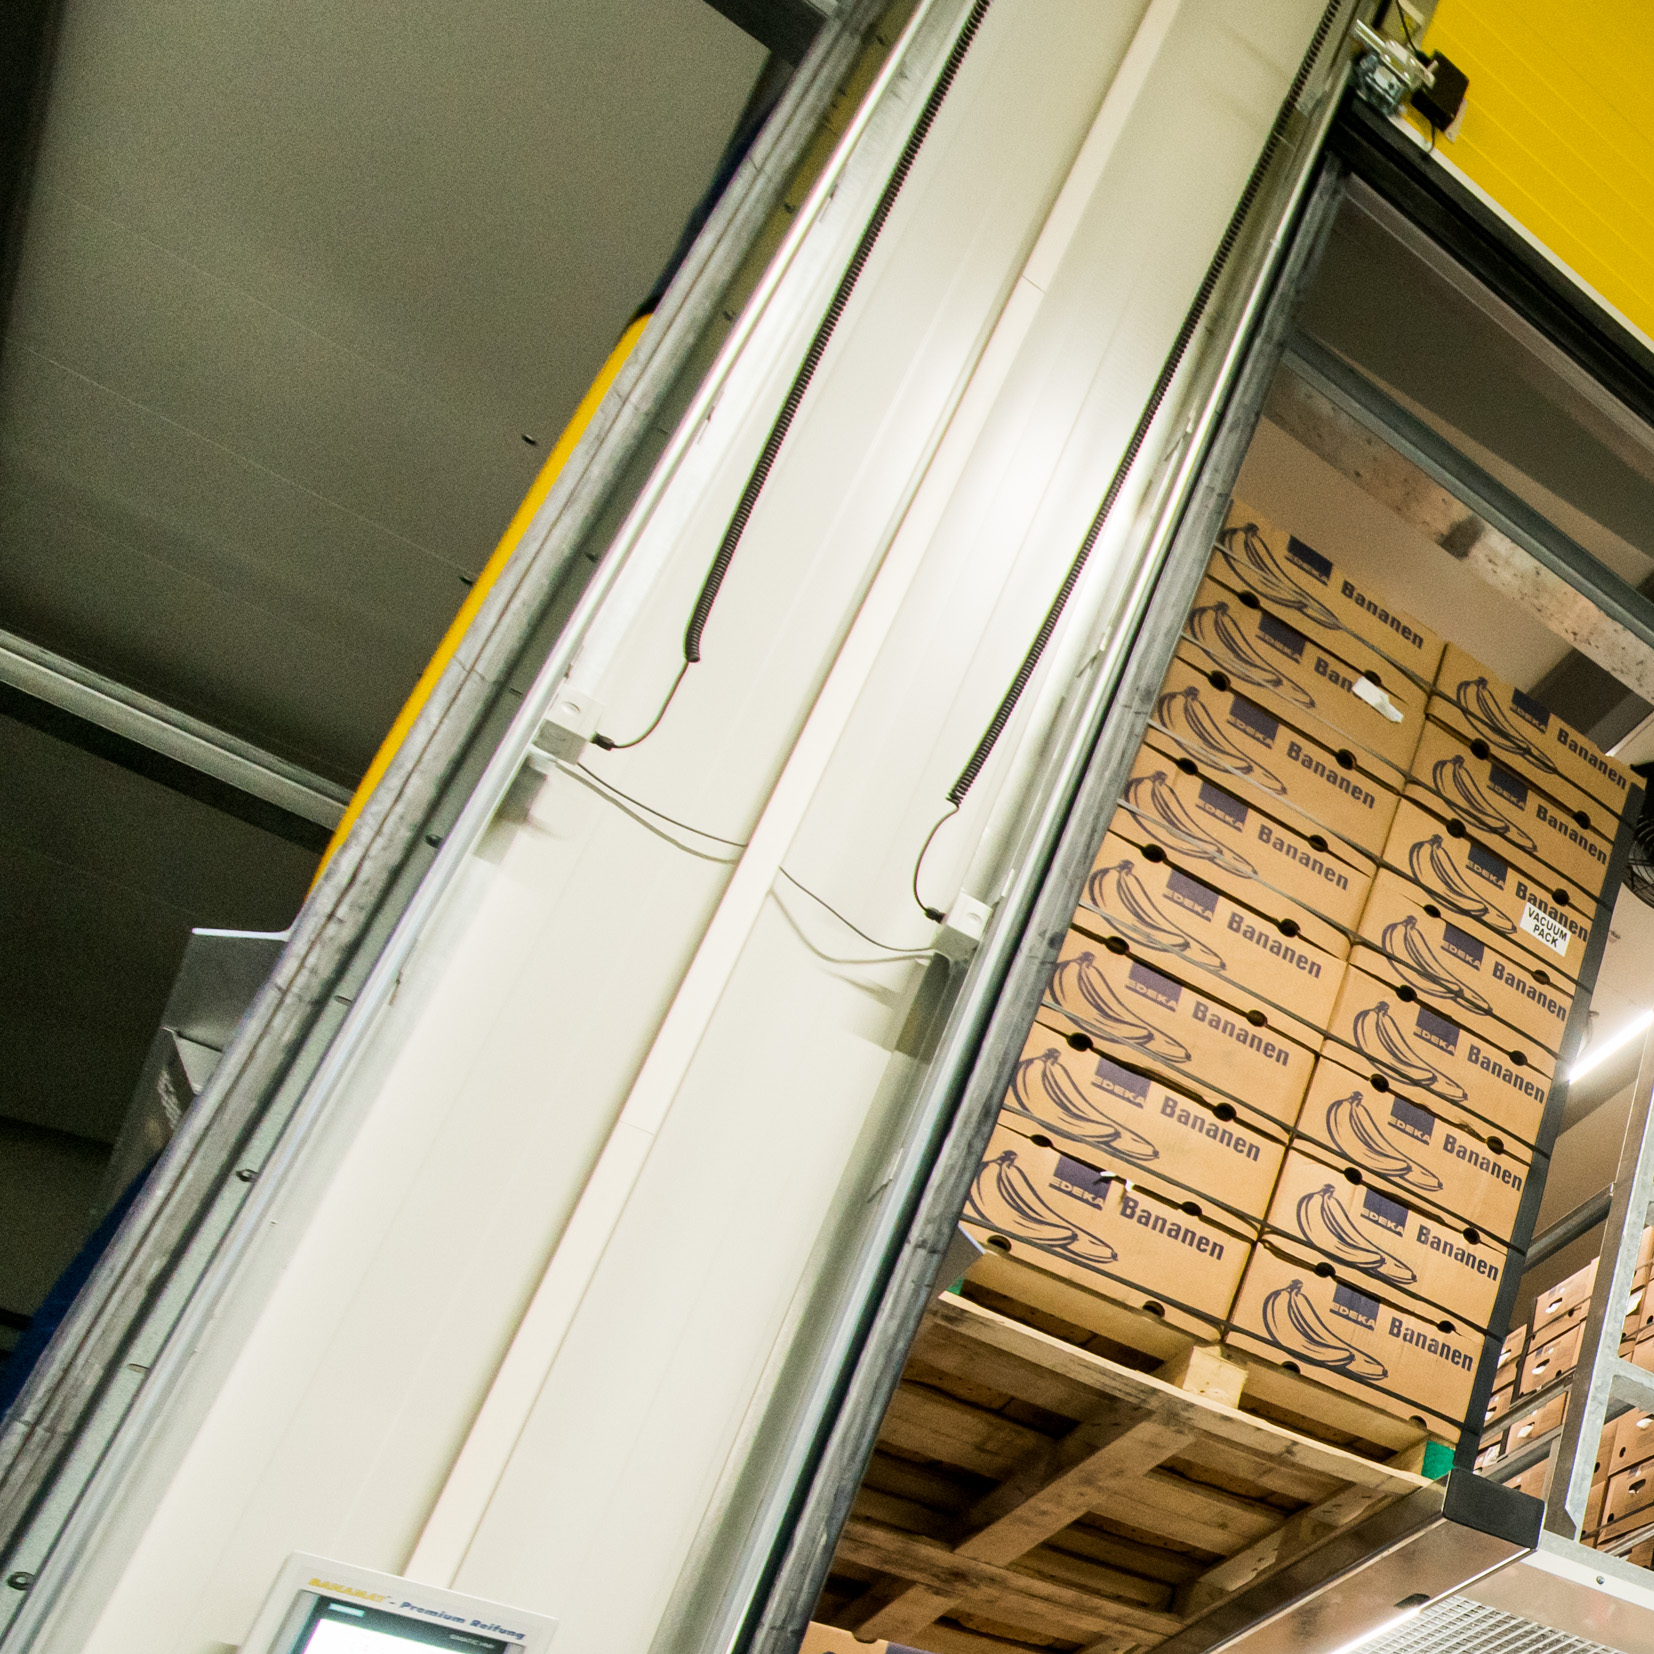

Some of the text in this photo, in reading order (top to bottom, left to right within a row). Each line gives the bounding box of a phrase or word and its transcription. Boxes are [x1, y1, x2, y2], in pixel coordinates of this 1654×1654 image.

[1341, 579, 1424, 649] Bananen
[1286, 740, 1375, 809] Bananen
[1557, 727, 1627, 790] Bananen
[1258, 824, 1349, 891] Bananen
[1536, 804, 1607, 865] Bananen
[1227, 911, 1322, 979] Bananen
[1527, 906, 1568, 942] VACUUM
[1532, 924, 1559, 948] PACK
[1492, 961, 1567, 1022] Bananen
[1193, 1000, 1290, 1066] Bananen
[1467, 1044, 1546, 1105] Bananen
[1160, 1096, 1261, 1162] Bananen
[1388, 1117, 1523, 1192] EDEKA Bananen
[1120, 1194, 1225, 1260] Bananen
[1360, 1208, 1499, 1282] EDEKA Bananen
[1330, 1303, 1473, 1372] EDEKA Bananen
[400, 1602, 467, 1625] Premium
[469, 1619, 526, 1640] Reifung
